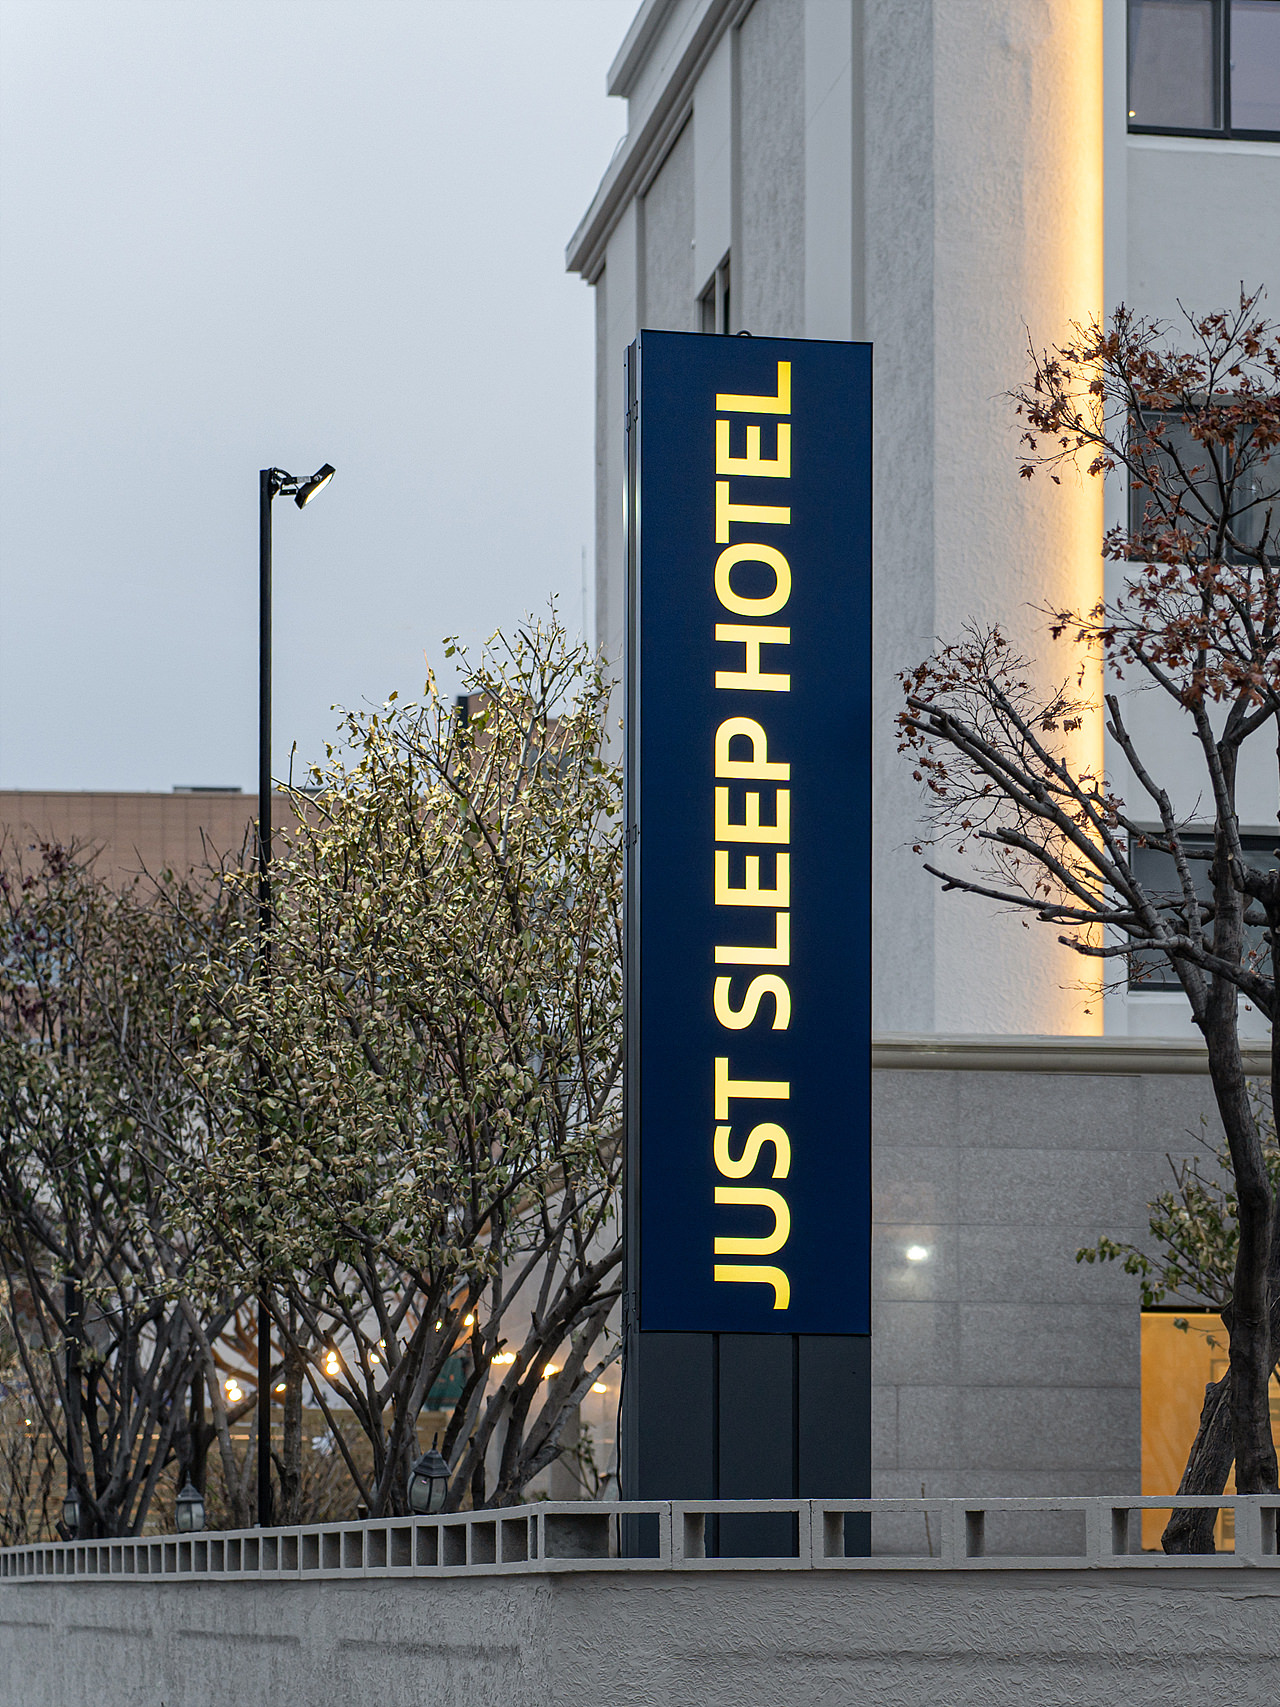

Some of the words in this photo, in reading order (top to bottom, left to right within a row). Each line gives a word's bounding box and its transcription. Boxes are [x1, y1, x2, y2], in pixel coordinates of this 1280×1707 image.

[714, 361, 791, 691] HOTEL
[714, 717, 791, 1031] SLEEP
[713, 1058, 790, 1310] JUST
